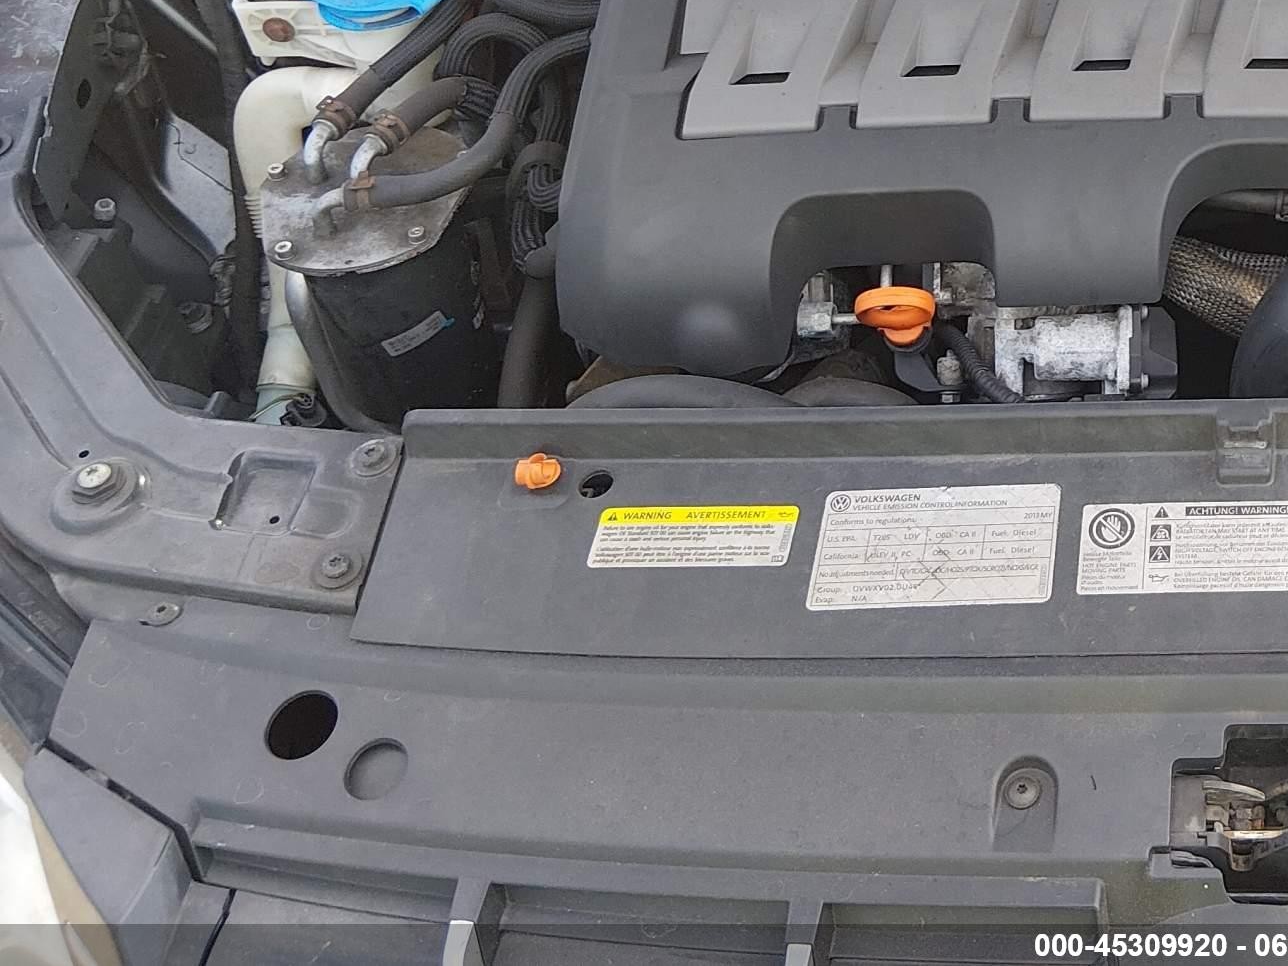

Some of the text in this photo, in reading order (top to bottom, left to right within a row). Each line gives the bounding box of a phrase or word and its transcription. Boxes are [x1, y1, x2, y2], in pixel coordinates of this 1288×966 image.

[854, 493, 921, 503] VOLKSWAGEN
[883, 502, 918, 510] EMISSION
[919, 501, 954, 509] CONTROL
[955, 500, 1008, 508] INFORMATION
[623, 510, 767, 520] WARNING AVERTISSEMENT
[1189, 507, 1239, 515] ACHTUNG!
[830, 518, 865, 526] Conforms
[1012, 528, 1037, 536] Diesel
[1011, 546, 1036, 554] Diesel
[851, 595, 868, 603] N/A
